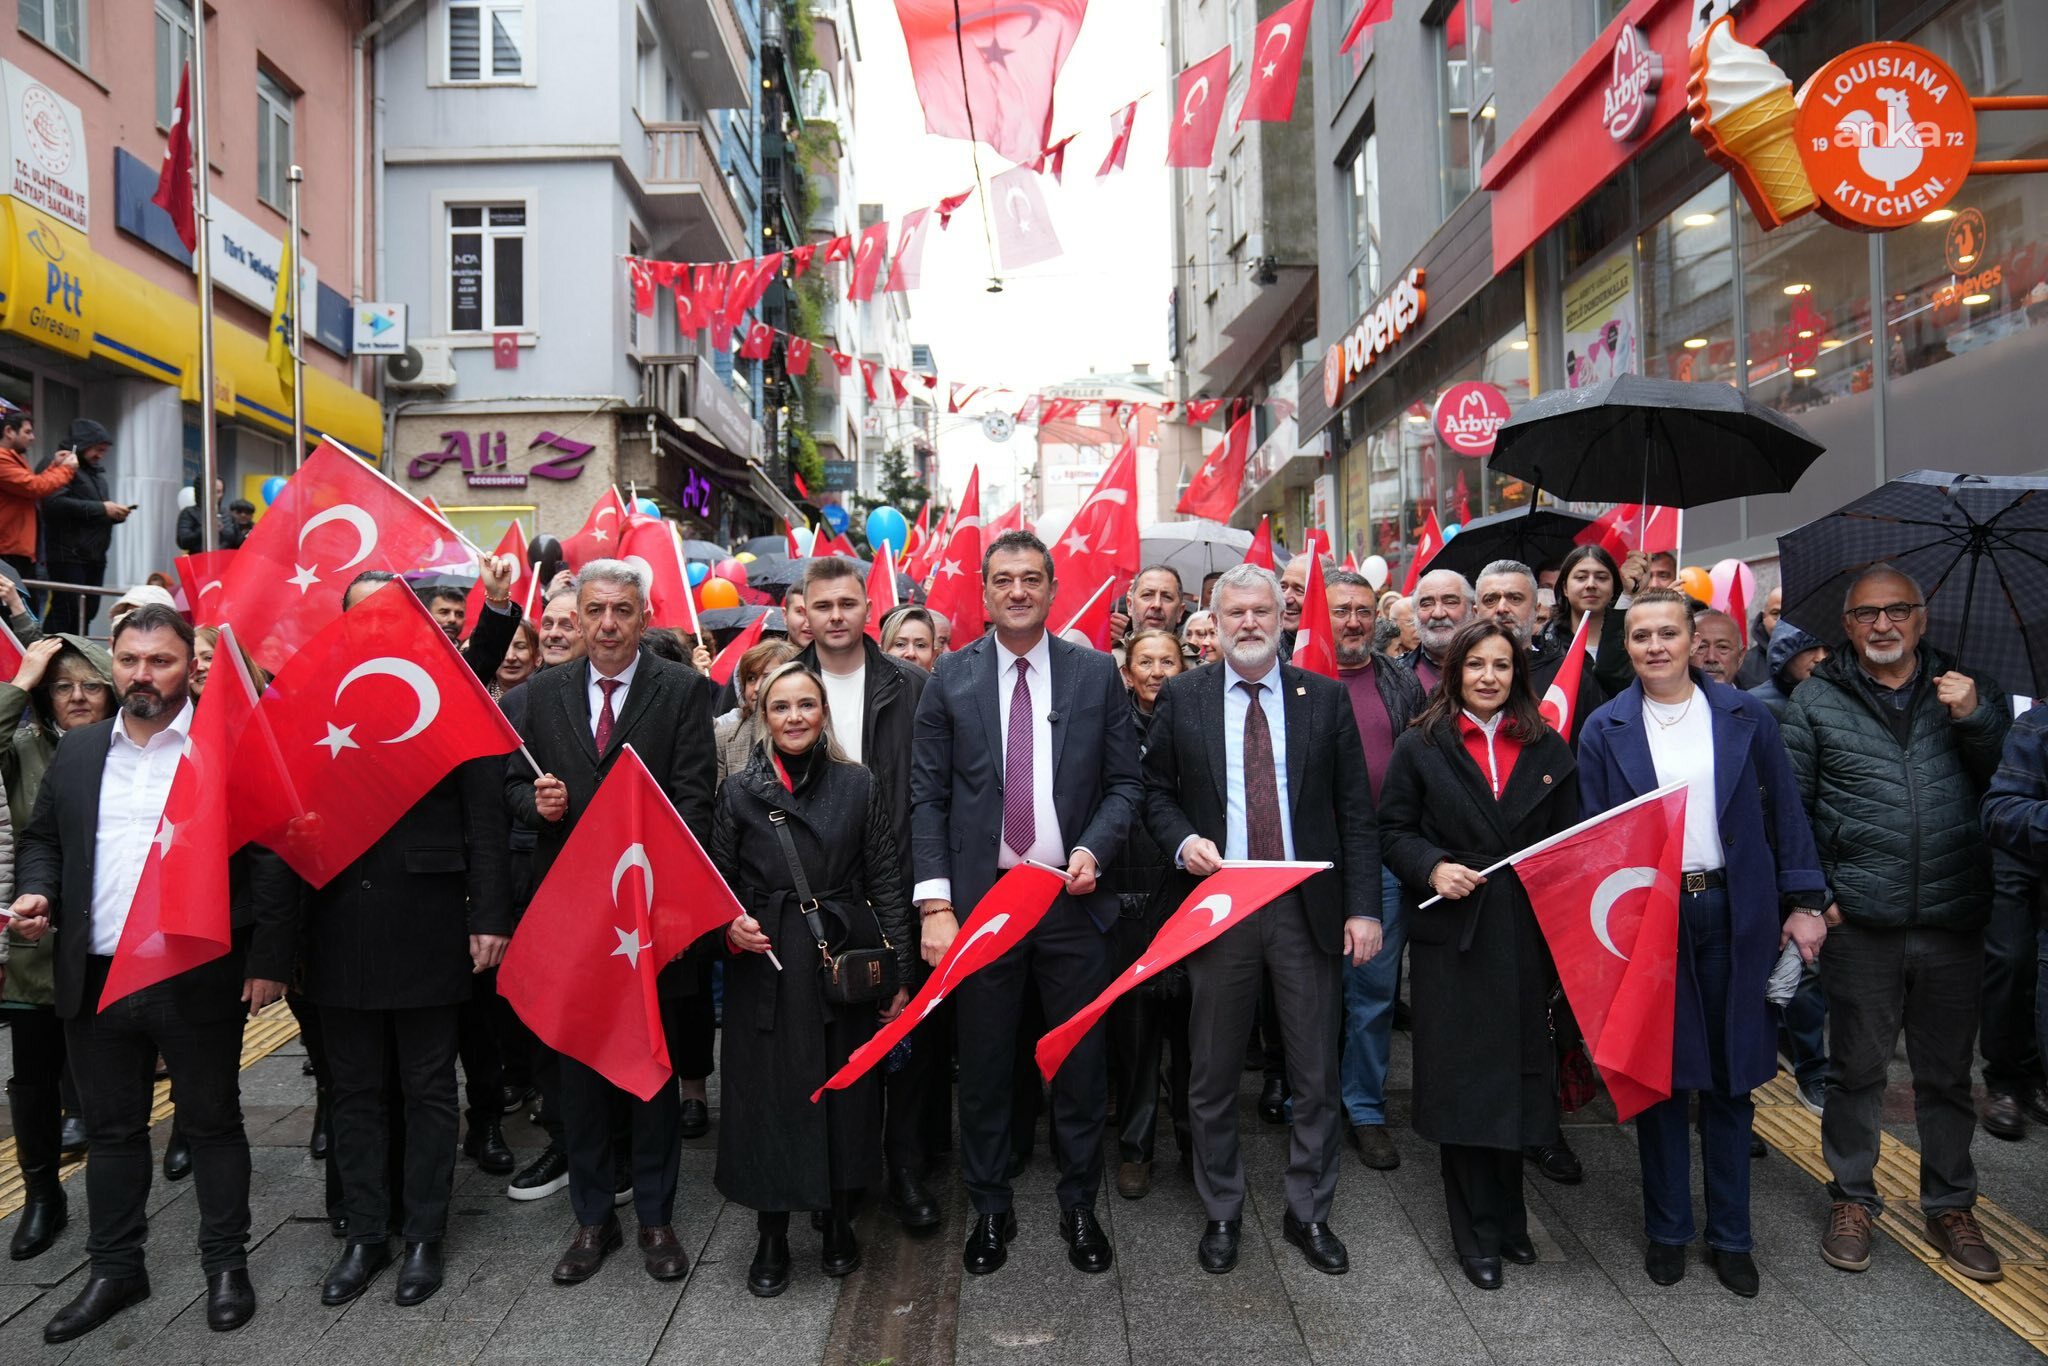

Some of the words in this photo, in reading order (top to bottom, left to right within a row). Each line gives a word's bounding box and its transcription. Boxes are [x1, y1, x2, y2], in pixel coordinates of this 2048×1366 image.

[1603, 54, 1649, 124] Arby's
[1822, 57, 1949, 107] LOUISIANA
[1811, 137, 1829, 152] 19
[1945, 131, 1964, 147] 72
[1834, 175, 1945, 217] KITCHEN
[247, 251, 280, 285] Telek
[30, 305, 81, 343] Giresun
[1444, 411, 1505, 436] Arby's
[407, 430, 508, 480] Ali
[528, 430, 597, 481] Z
